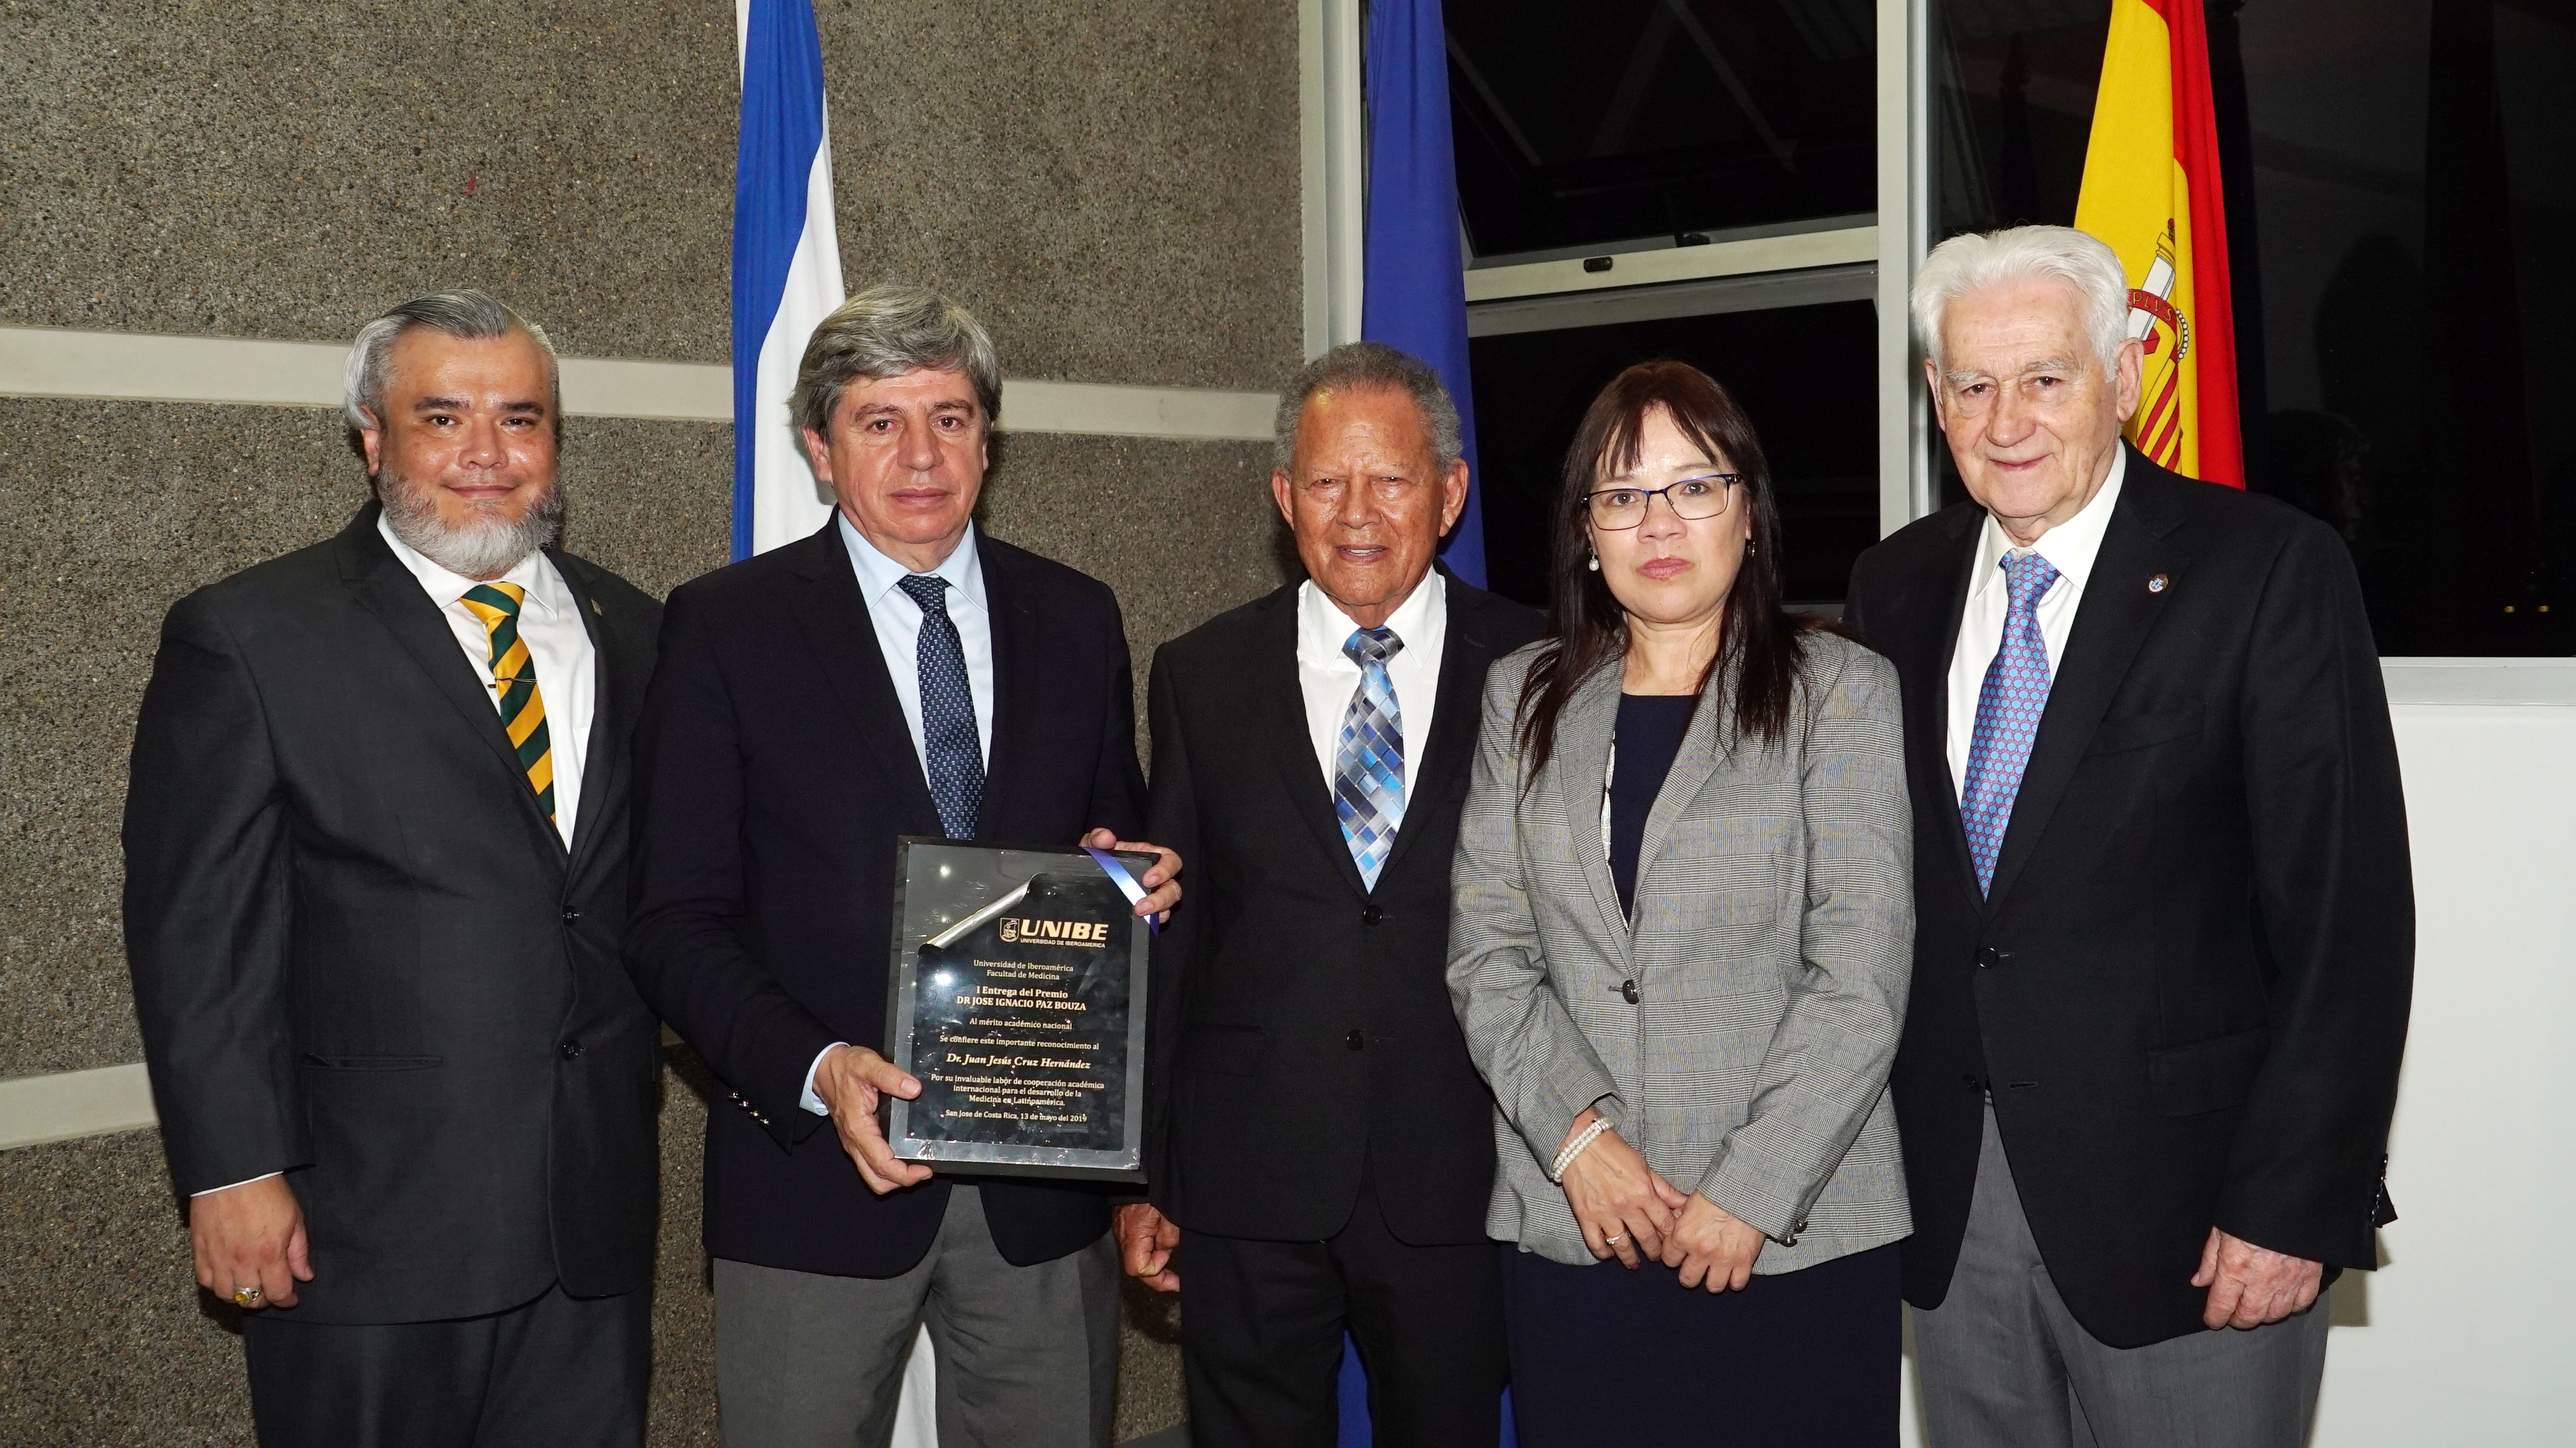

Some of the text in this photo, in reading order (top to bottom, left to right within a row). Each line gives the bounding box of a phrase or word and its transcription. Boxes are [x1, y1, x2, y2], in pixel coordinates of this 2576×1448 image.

[2132, 292, 2172, 321] PLVS
[1020, 919, 1109, 941] UNIBE
[973, 960, 1016, 969] Universidad
[1027, 963, 1074, 972] Iberoamérica
[976, 985, 1069, 999] I Entrega del Premio
[956, 995, 1087, 1011] DR JOSE IGNACIO PAZ BOUZA
[979, 1018, 1003, 1026] mérito
[996, 1037, 1036, 1047] importante
[1036, 1041, 1092, 1050] reconocimiento
[946, 1053, 1092, 1069] Dr. Juan Jesús Cruz Hernández
[954, 1074, 992, 1084] invaluable
[993, 1076, 1013, 1085] labor
[1067, 1081, 1105, 1089] académica
[953, 1084, 1001, 1093] internacional
[1027, 1087, 1064, 1096] desarrollo
[968, 1095, 1002, 1103] Medicina
[1013, 1096, 1066, 1106] Latinoamérica.
